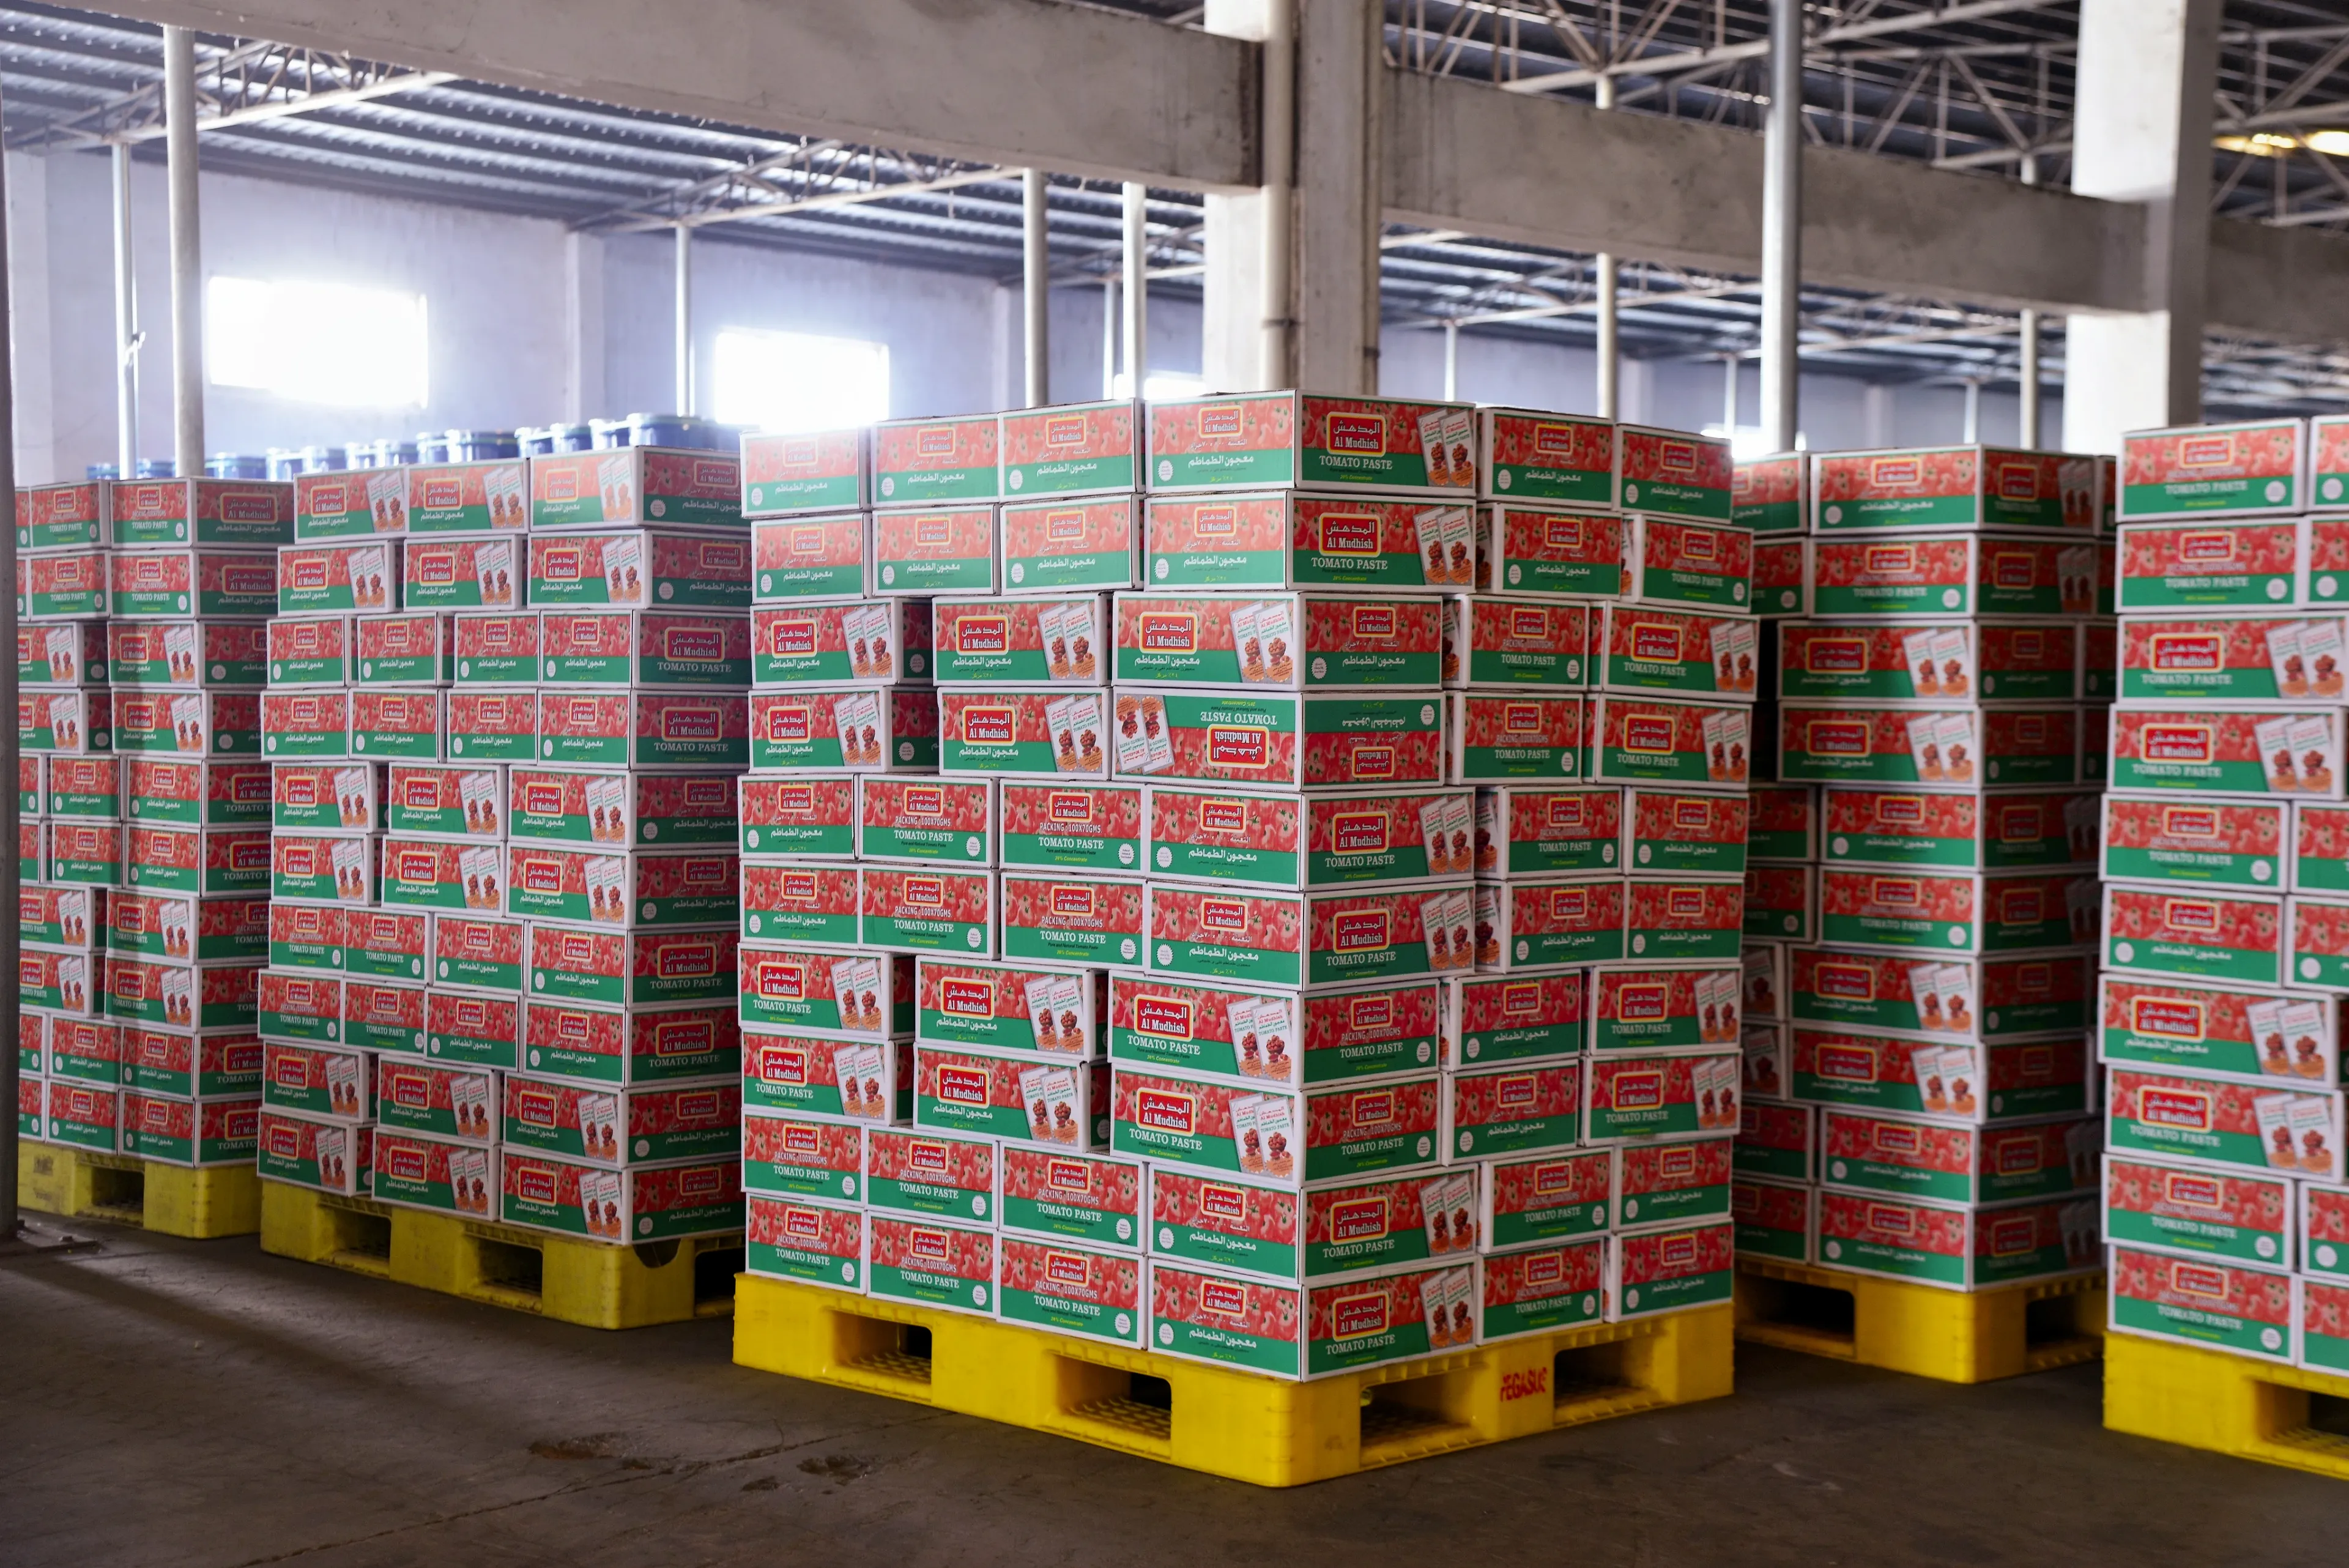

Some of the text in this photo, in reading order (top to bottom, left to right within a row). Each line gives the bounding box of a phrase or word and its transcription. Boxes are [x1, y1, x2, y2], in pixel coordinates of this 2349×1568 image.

[1212, 423, 1237, 432] Mudhish
[1334, 436, 1378, 450] Al Mudhish
[1189, 455, 1253, 468] معجون الطماطم
[1319, 455, 1392, 469] TOMATO PASTE
[428, 496, 457, 505] Al Mudhish
[420, 511, 444, 521] الطماطم
[783, 570, 833, 582] معجون الطماطم
[1359, 623, 1390, 632] Al Mudhish
[777, 641, 811, 652] Al Mudhish
[1146, 636, 1190, 647] Al Mudhish
[769, 659, 820, 670] معجون الطماطم
[1135, 655, 1200, 667] معجون الطماطم
[1343, 655, 1406, 667] معجون الطماطم
[1501, 654, 1556, 665] TOMATO PASTE
[1200, 712, 1277, 725] TOMATO PASTE
[669, 726, 714, 735] Al Mudhish
[1215, 732, 1261, 744] Al Mudhish
[654, 743, 696, 751] TOMATO
[1617, 754, 1679, 766] TOMATO PASTE
[528, 878, 557, 889] Al Mudhish
[520, 894, 544, 902] الطماطم
[1064, 903, 1088, 912] Mudhish
[1041, 916, 1066, 926] PACKING
[1215, 916, 1241, 926] Mudhish
[1040, 931, 1106, 943] TOMATO PASTE
[1340, 932, 1382, 946] Al Mudhish
[1189, 946, 1258, 961] معجون الطماطم
[1327, 951, 1396, 966] TOMATO PASTE
[1141, 1018, 1186, 1034] Al Mudhish
[1127, 1035, 1200, 1055] TOMATO PASTE
[943, 1087, 982, 1101] Al Mudhish
[933, 1104, 992, 1119] معجون الطماطم
[1358, 1109, 1388, 1121] Al Mudhish
[794, 1140, 815, 1150] Mudhish
[1341, 1137, 1404, 1155] TOMATO PASTE
[774, 1151, 796, 1161] PACKING
[773, 1165, 829, 1180] TOMATO PASTE
[1337, 1221, 1381, 1238] Al Mudhish
[1323, 1239, 1395, 1258] TOMATO PASTE
[1059, 1270, 1083, 1281] Mudhish
[1035, 1280, 1060, 1293] PACKING
[1034, 1295, 1100, 1316] TOMATO PASTE
